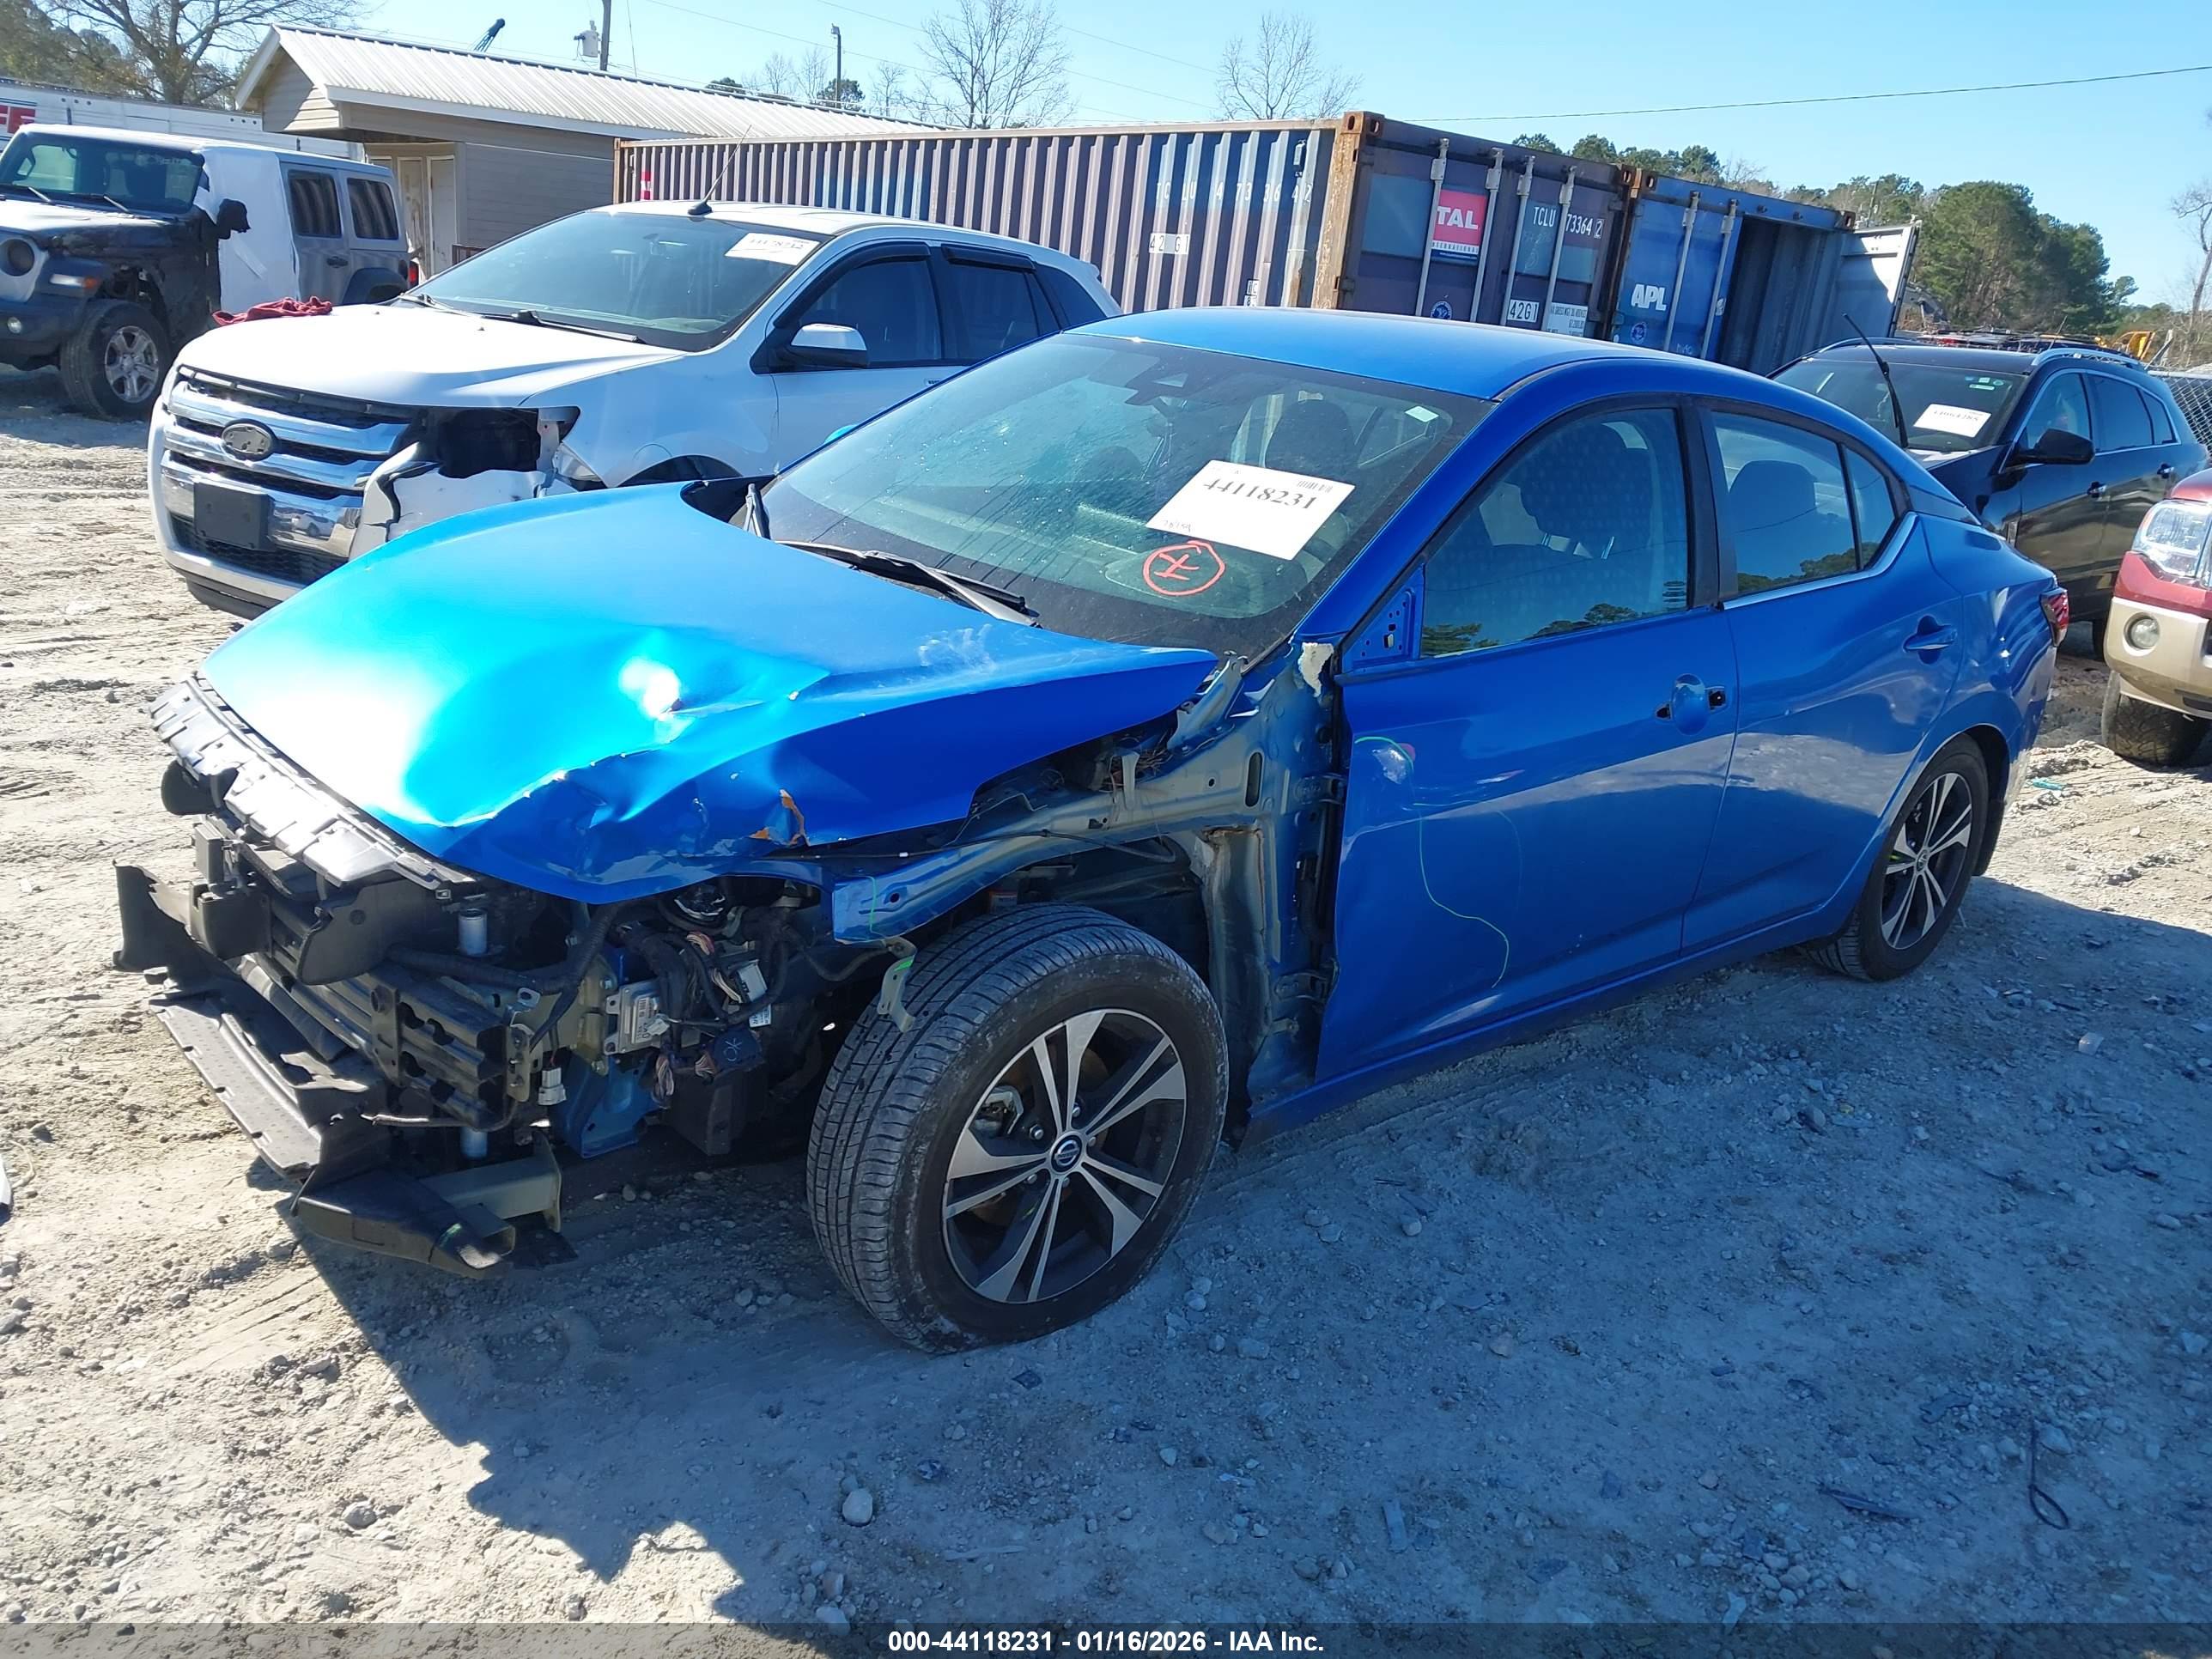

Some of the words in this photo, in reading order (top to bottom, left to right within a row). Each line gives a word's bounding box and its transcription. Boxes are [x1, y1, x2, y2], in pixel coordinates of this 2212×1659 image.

[1437, 205, 1479, 230] TAL
[1533, 206, 1558, 228] TCLU
[1565, 214, 1594, 236] 73364
[1510, 301, 1538, 321] 42G1
[1632, 283, 1667, 312] APL
[1203, 478, 1317, 508] 44118231
